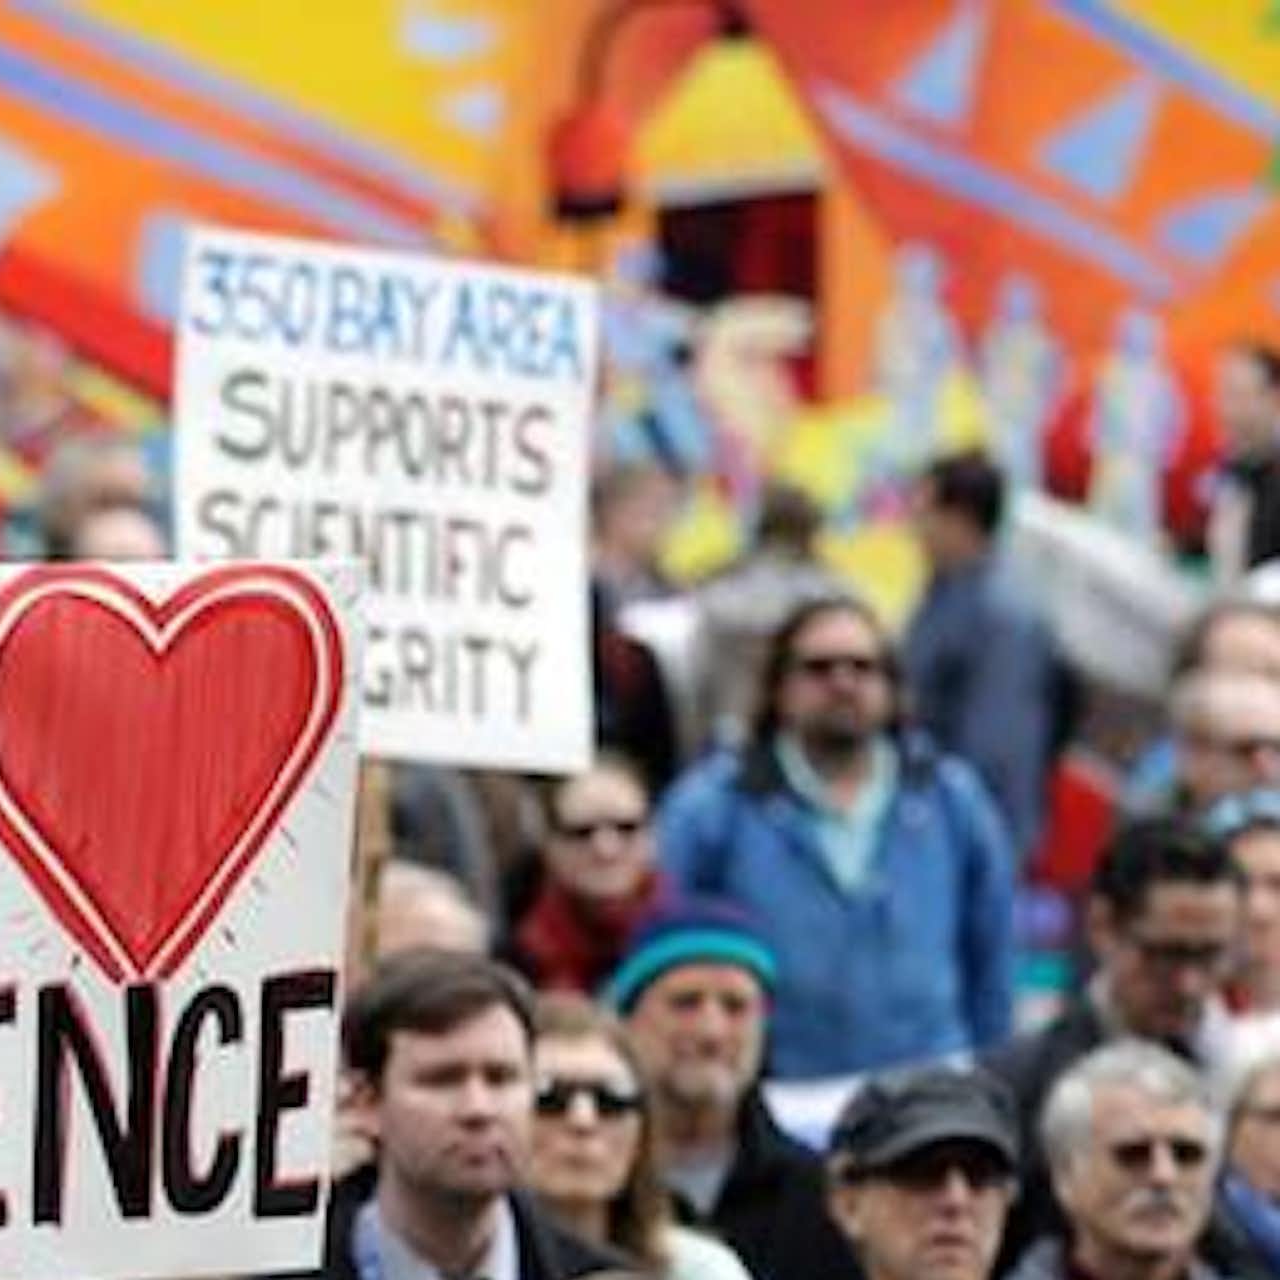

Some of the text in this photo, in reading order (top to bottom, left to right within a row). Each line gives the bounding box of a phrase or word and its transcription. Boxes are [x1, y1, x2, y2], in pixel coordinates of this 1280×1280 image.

[192, 249, 584, 380] 350 BAY AREA
[214, 369, 556, 497] SUPPORTS
